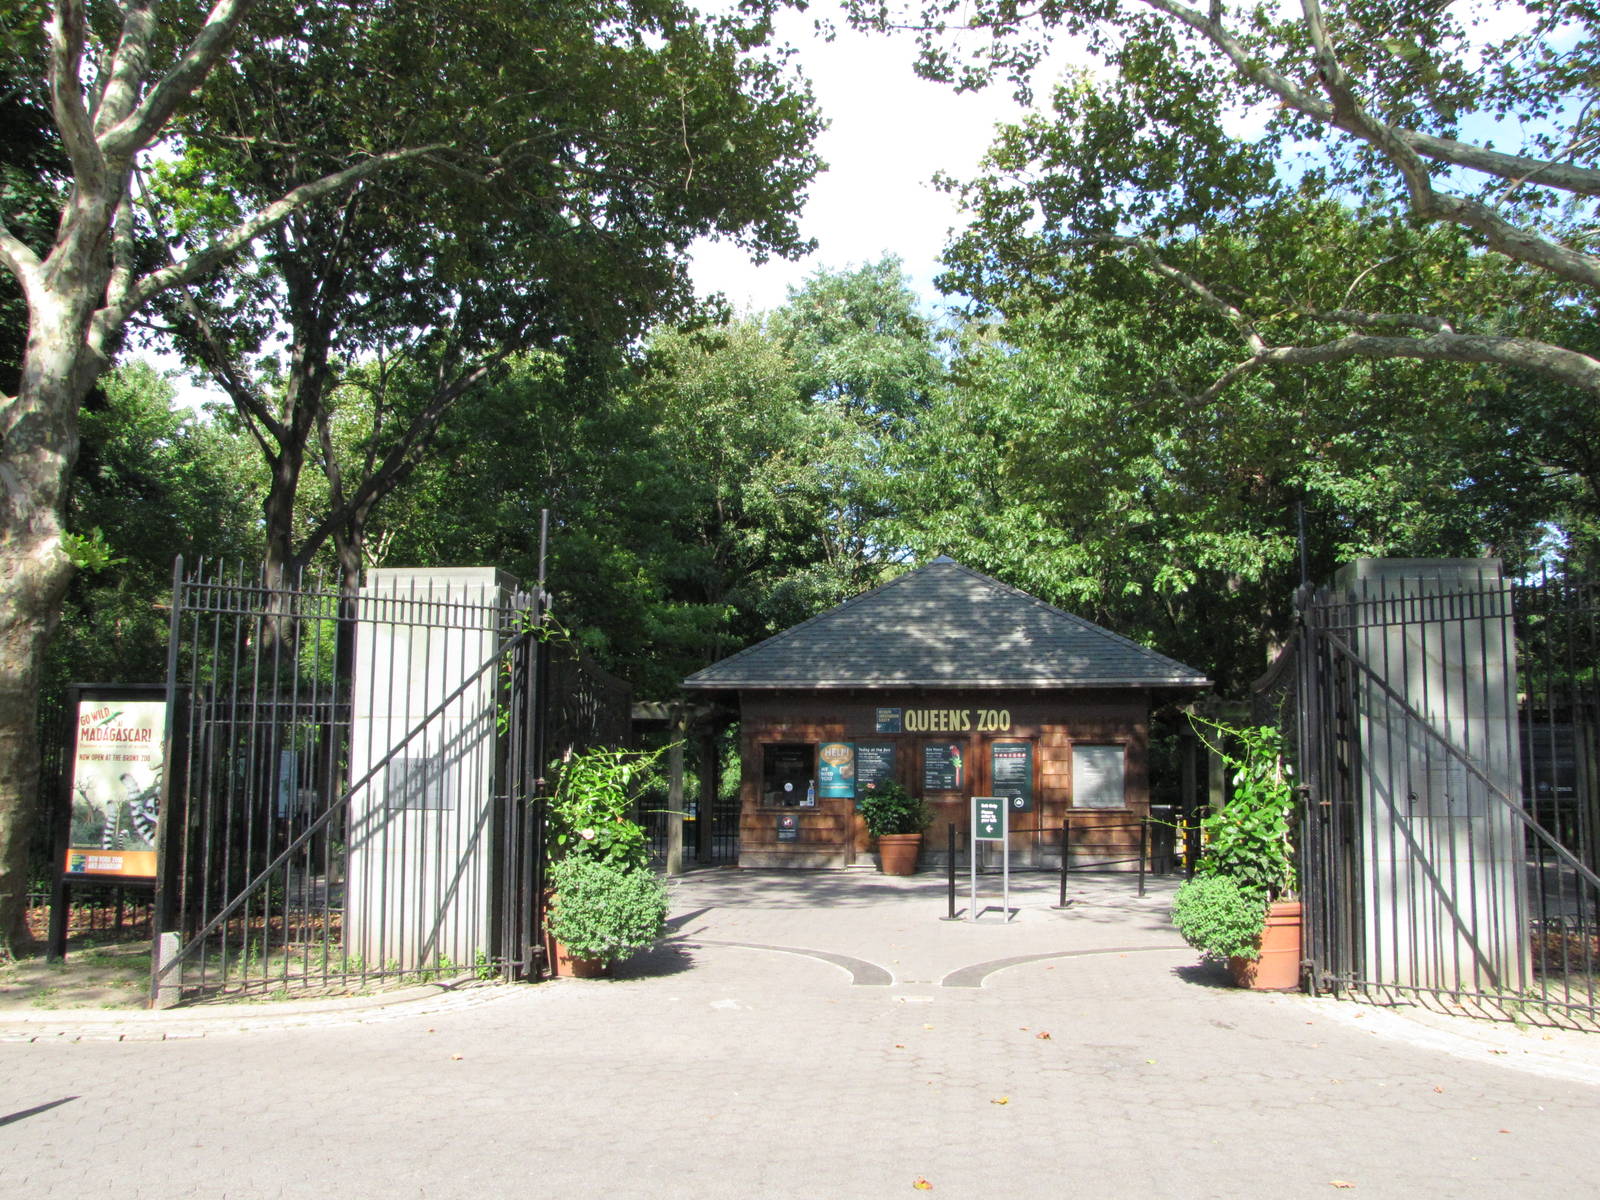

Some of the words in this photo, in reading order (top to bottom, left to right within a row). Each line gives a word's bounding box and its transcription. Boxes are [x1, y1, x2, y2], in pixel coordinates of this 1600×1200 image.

[80, 715, 91, 726] GO
[91, 706, 111, 722] WILD
[904, 709, 971, 732] QUEENS
[976, 709, 1011, 732] ZOO
[80, 728, 152, 742] MADAGASCAR!
[79, 753, 91, 761] NOW
[91, 753, 105, 761] OPEN
[825, 747, 850, 757] HELP!
